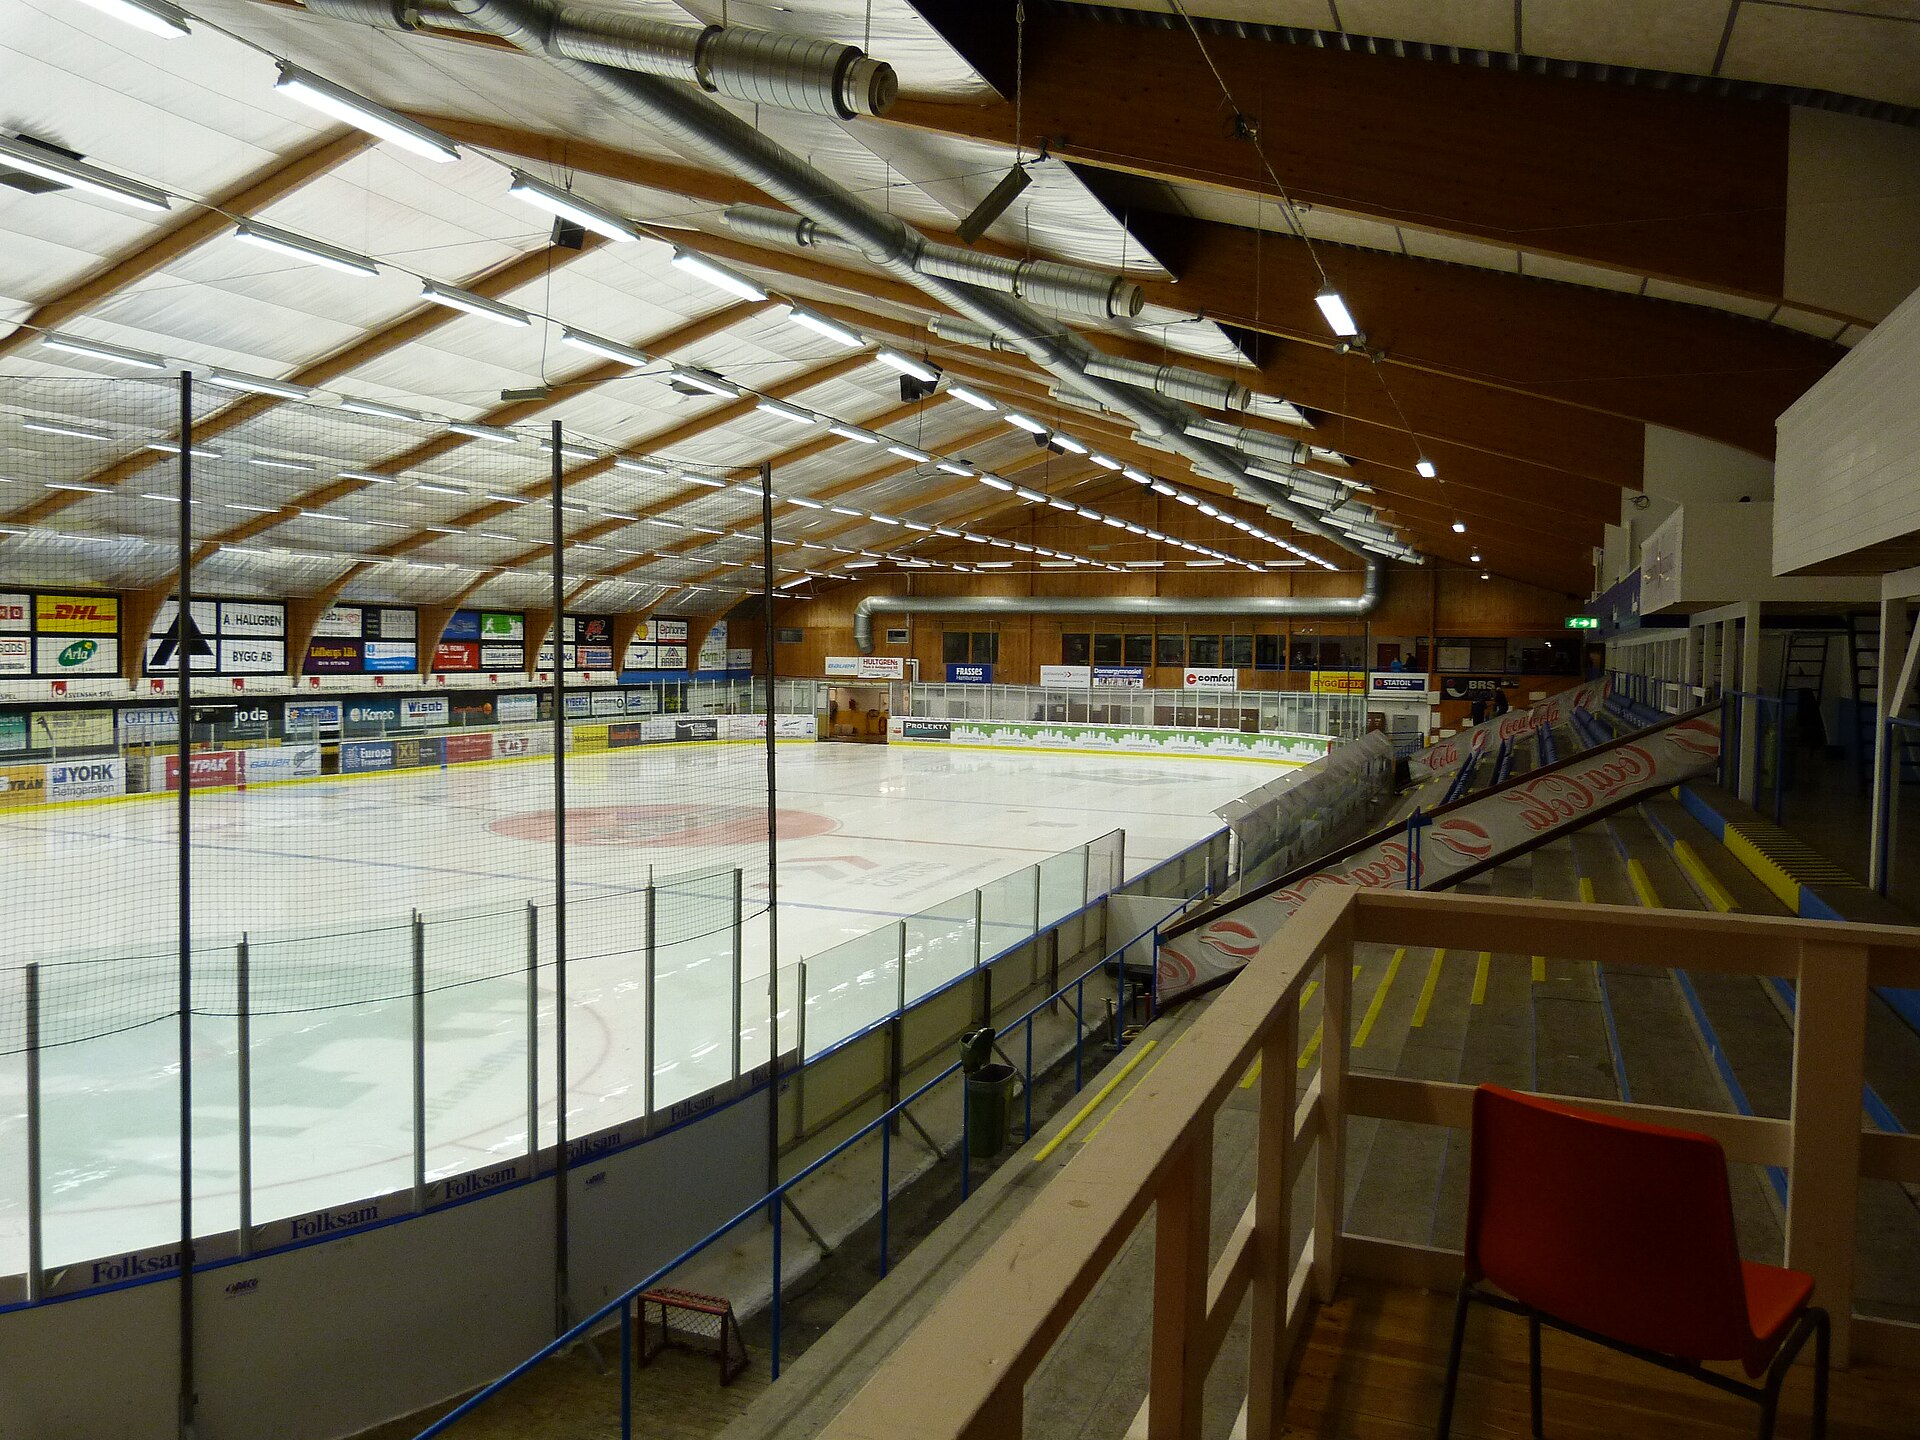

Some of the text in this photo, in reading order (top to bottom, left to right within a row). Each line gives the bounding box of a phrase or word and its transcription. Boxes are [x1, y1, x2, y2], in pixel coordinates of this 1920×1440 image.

[55, 605, 101, 620] DHL
[235, 614, 282, 627] HALLGREN
[64, 647, 88, 660] Arla
[232, 651, 273, 662] BYGG AB
[540, 653, 573, 661] SKAKA
[1198, 674, 1235, 682] comfort
[1468, 680, 1496, 690] BRS
[408, 701, 442, 712] Wisab
[125, 710, 180, 723] GETTA
[68, 764, 114, 782] YORK
[671, 1094, 715, 1123] Folksam
[445, 1165, 517, 1199] Folksam
[291, 1204, 378, 1240] Folksam
[92, 1249, 196, 1284] Folksa
